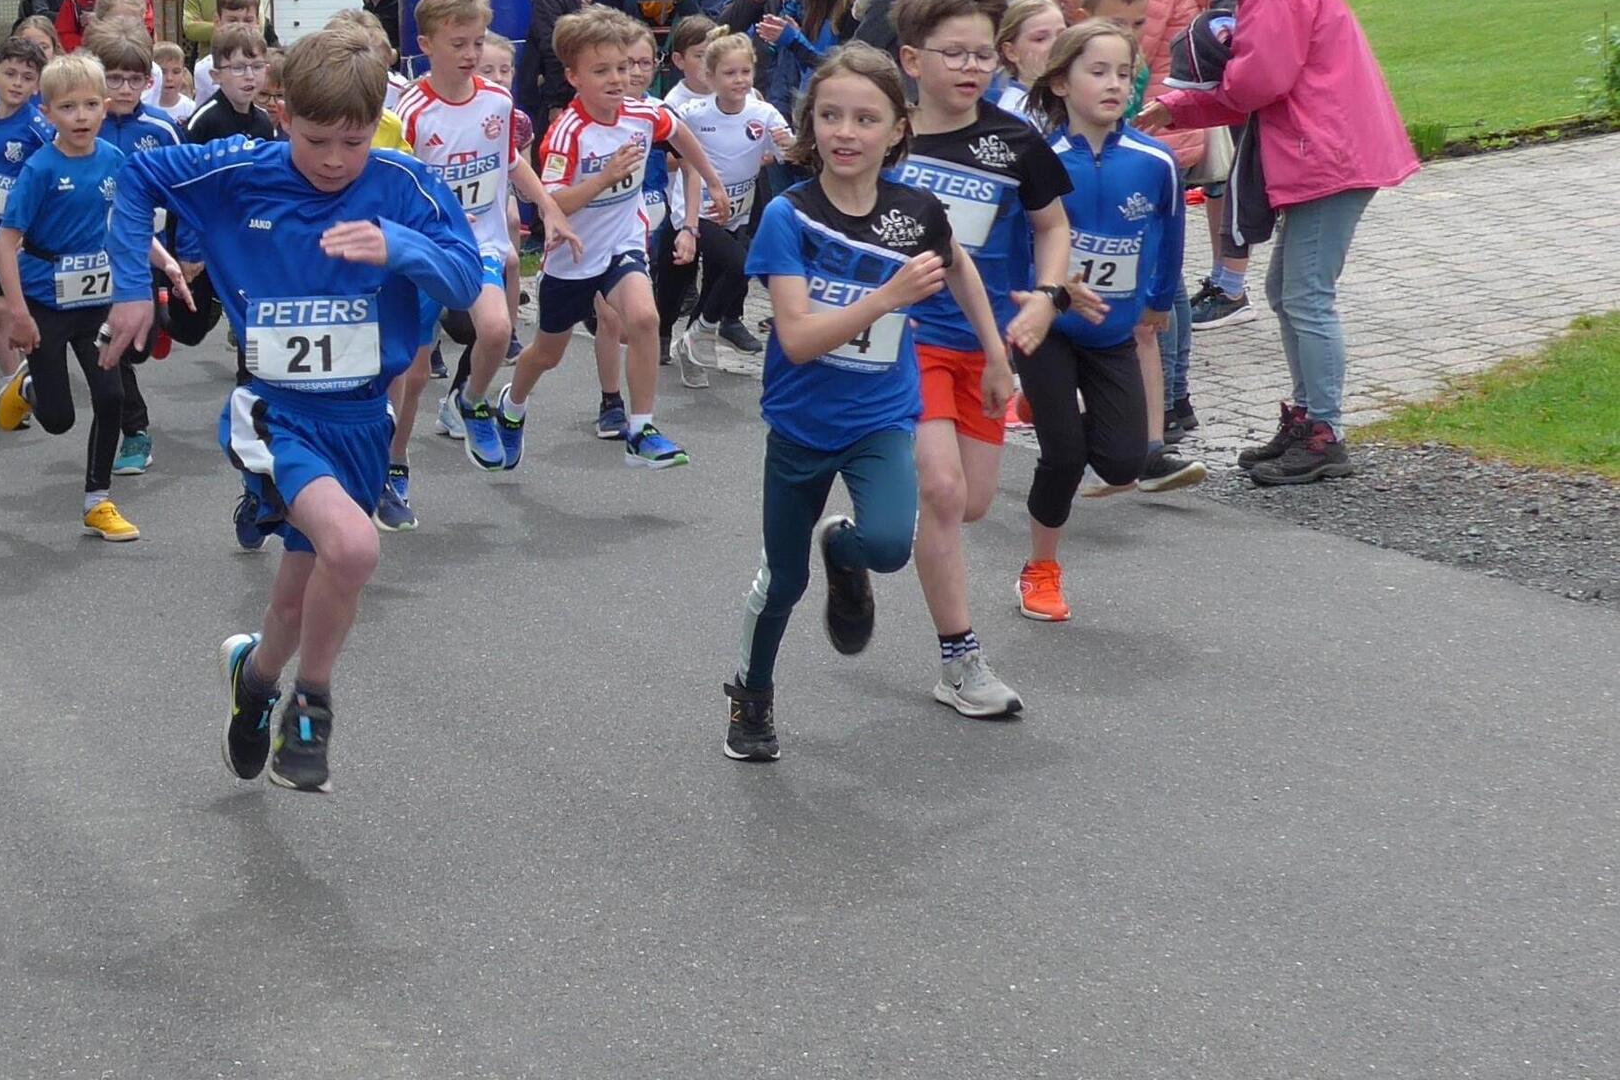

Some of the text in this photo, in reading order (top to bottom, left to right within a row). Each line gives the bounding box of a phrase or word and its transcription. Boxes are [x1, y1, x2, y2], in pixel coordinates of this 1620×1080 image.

[453, 181, 480, 206] 17
[727, 179, 757, 195] TERS
[900, 164, 995, 201] PETERS
[248, 219, 272, 230] JAKO
[61, 252, 110, 271] PETE
[1080, 259, 1117, 287] 12
[81, 272, 111, 296] 27
[257, 298, 369, 325] PETERS
[286, 334, 333, 373] 21
